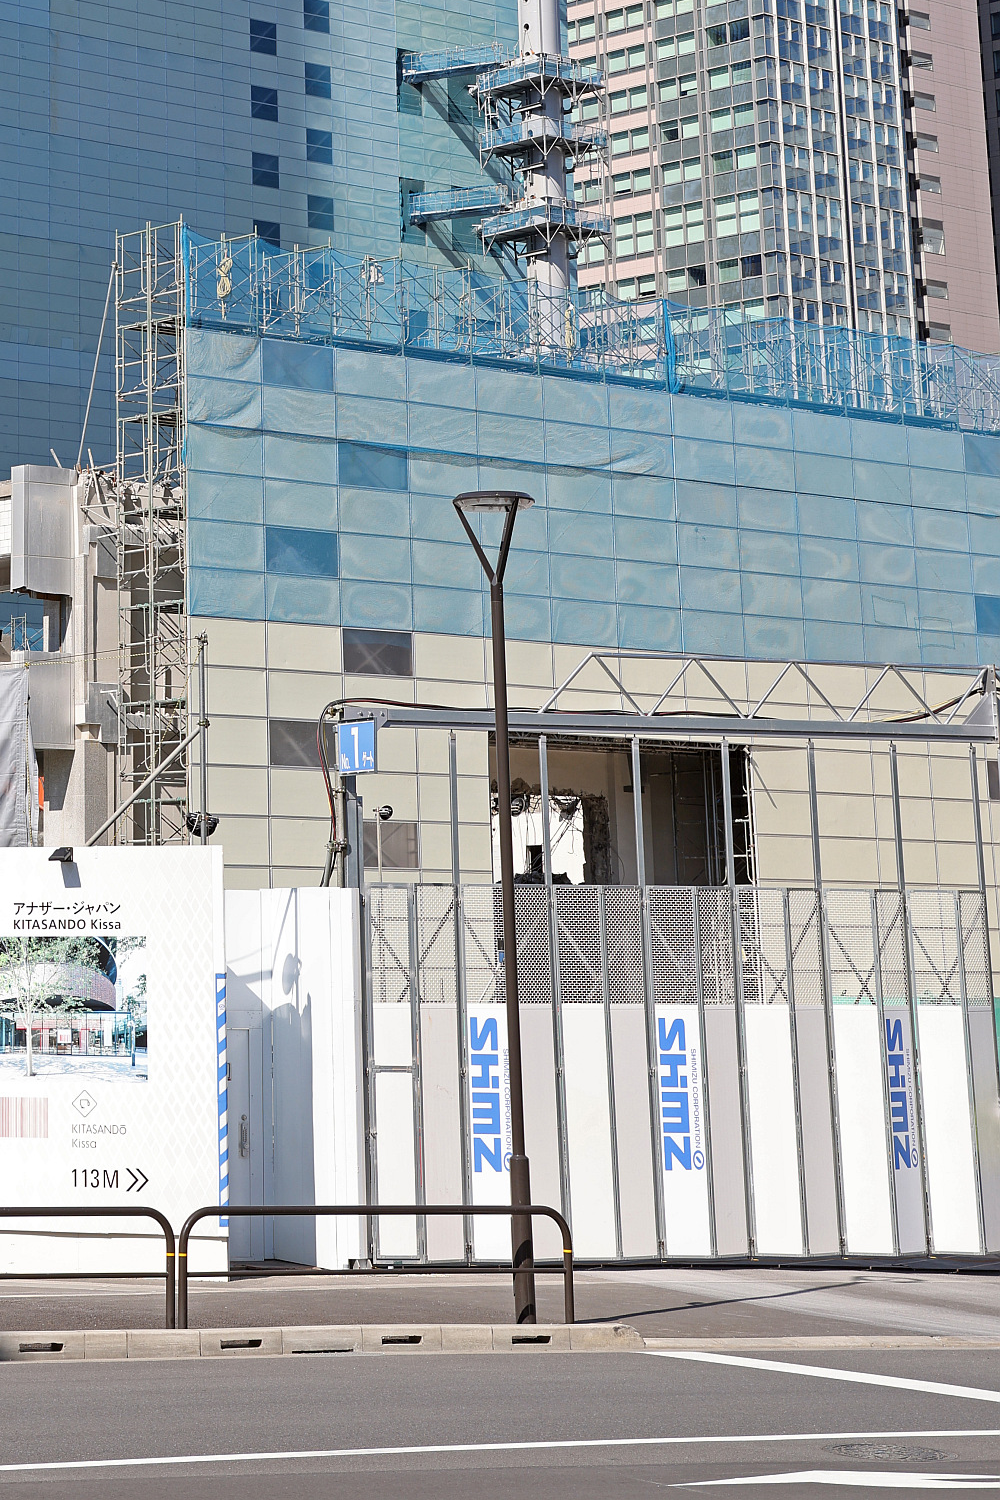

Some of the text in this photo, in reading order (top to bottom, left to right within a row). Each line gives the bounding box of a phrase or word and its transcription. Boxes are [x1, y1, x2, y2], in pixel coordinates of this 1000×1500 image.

[13, 901, 121, 916] アナザー・ジャパン
[13, 918, 121, 930] KITASANDO Kissa
[503, 1048, 512, 1150] SHIMIZU CORPORATION
[690, 1048, 700, 1148] SHIMIZU CORPORATION
[71, 1139, 97, 1149] Kissa
[71, 1168, 119, 1189] 113M
